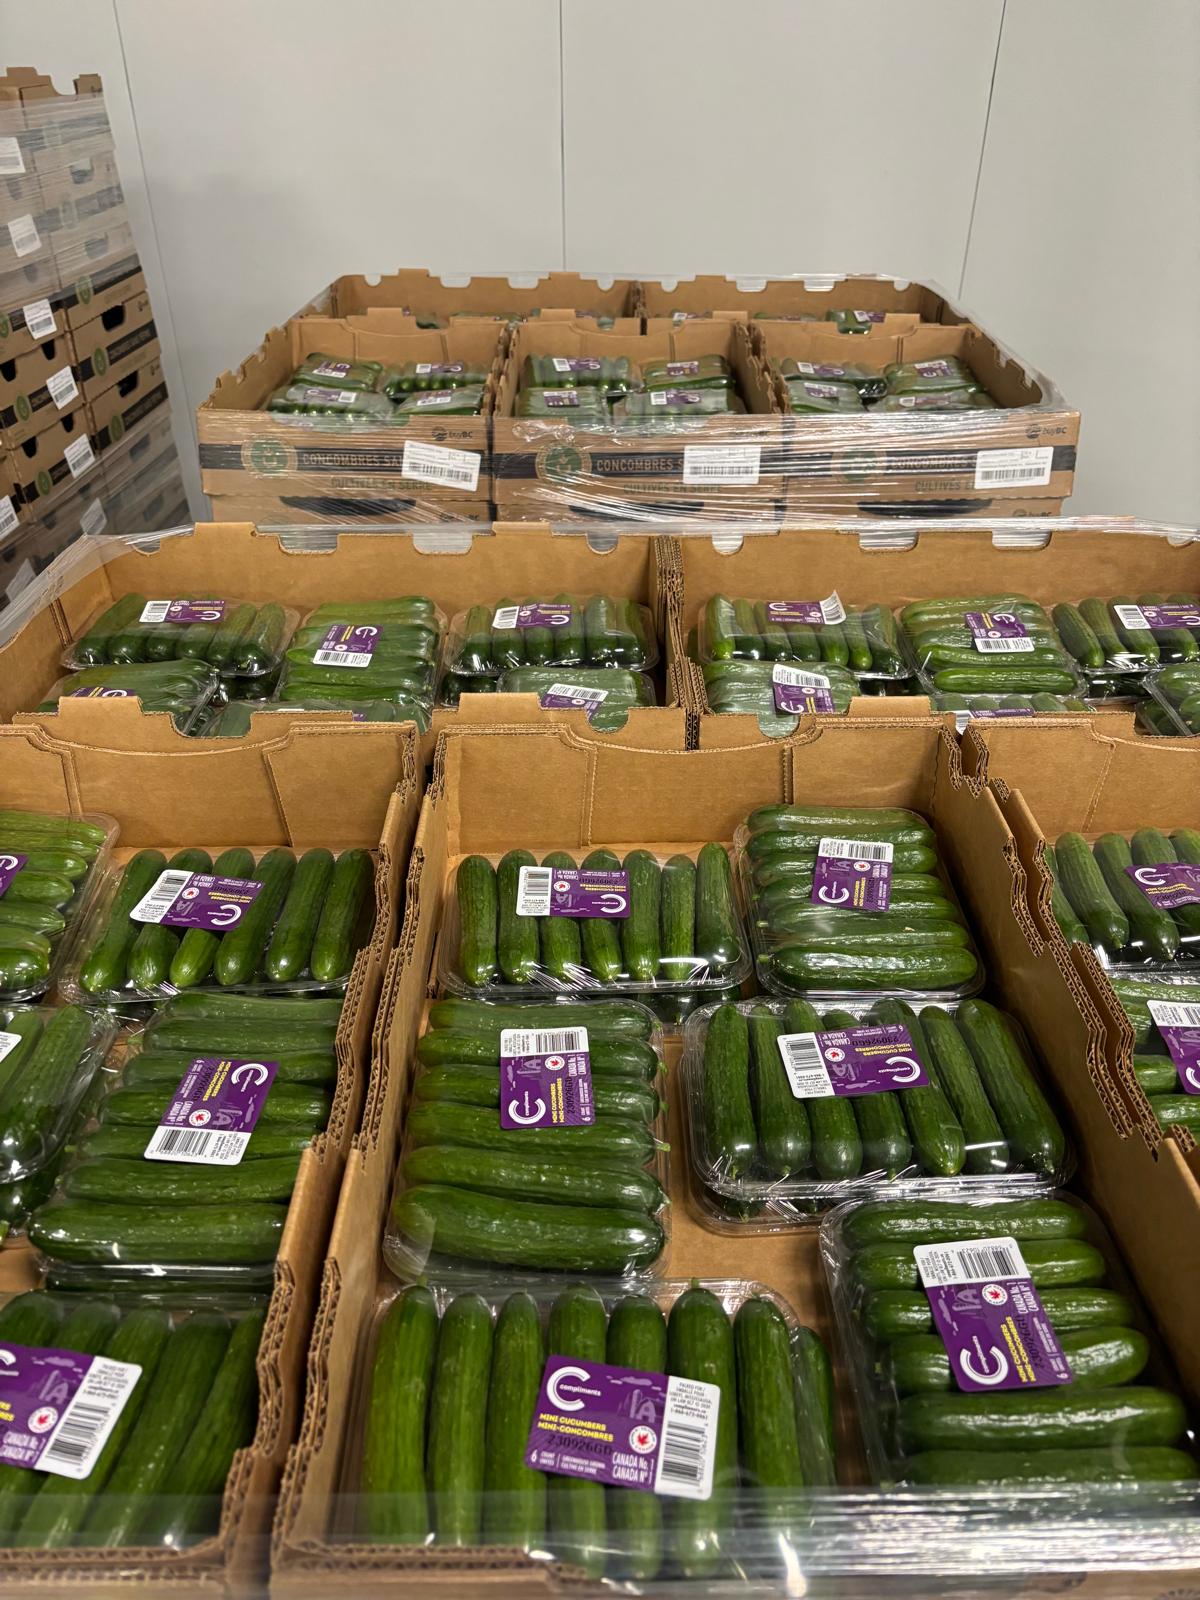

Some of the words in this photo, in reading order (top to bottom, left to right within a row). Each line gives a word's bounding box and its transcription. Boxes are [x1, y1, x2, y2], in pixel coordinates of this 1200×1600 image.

[303, 453, 379, 466] CONCOMBRES
[596, 458, 673, 472] CONCOMBRES
[828, 1031, 846, 1039] CANADA
[832, 1038, 850, 1046] CANADA
[1012, 1294, 1027, 1314] CANADA
[1022, 1291, 1039, 1311] CANADA
[1000, 1324, 1020, 1364] CUCUMBERS
[1005, 1316, 1036, 1382] MINI-CONCOMBRES
[972, 1335, 989, 1373] compliments
[1017, 1365, 1028, 1382] MINI
[559, 1384, 601, 1396] compliments
[539, 1413, 558, 1422] MINI
[559, 1417, 607, 1431] CUCUMBERS
[537, 1422, 614, 1442] MINI-CONCOMBRES
[531, 1449, 538, 1462] 6
[612, 1452, 638, 1467] CANADA
[639, 1455, 649, 1469] No.
[612, 1465, 638, 1481] CANADA
